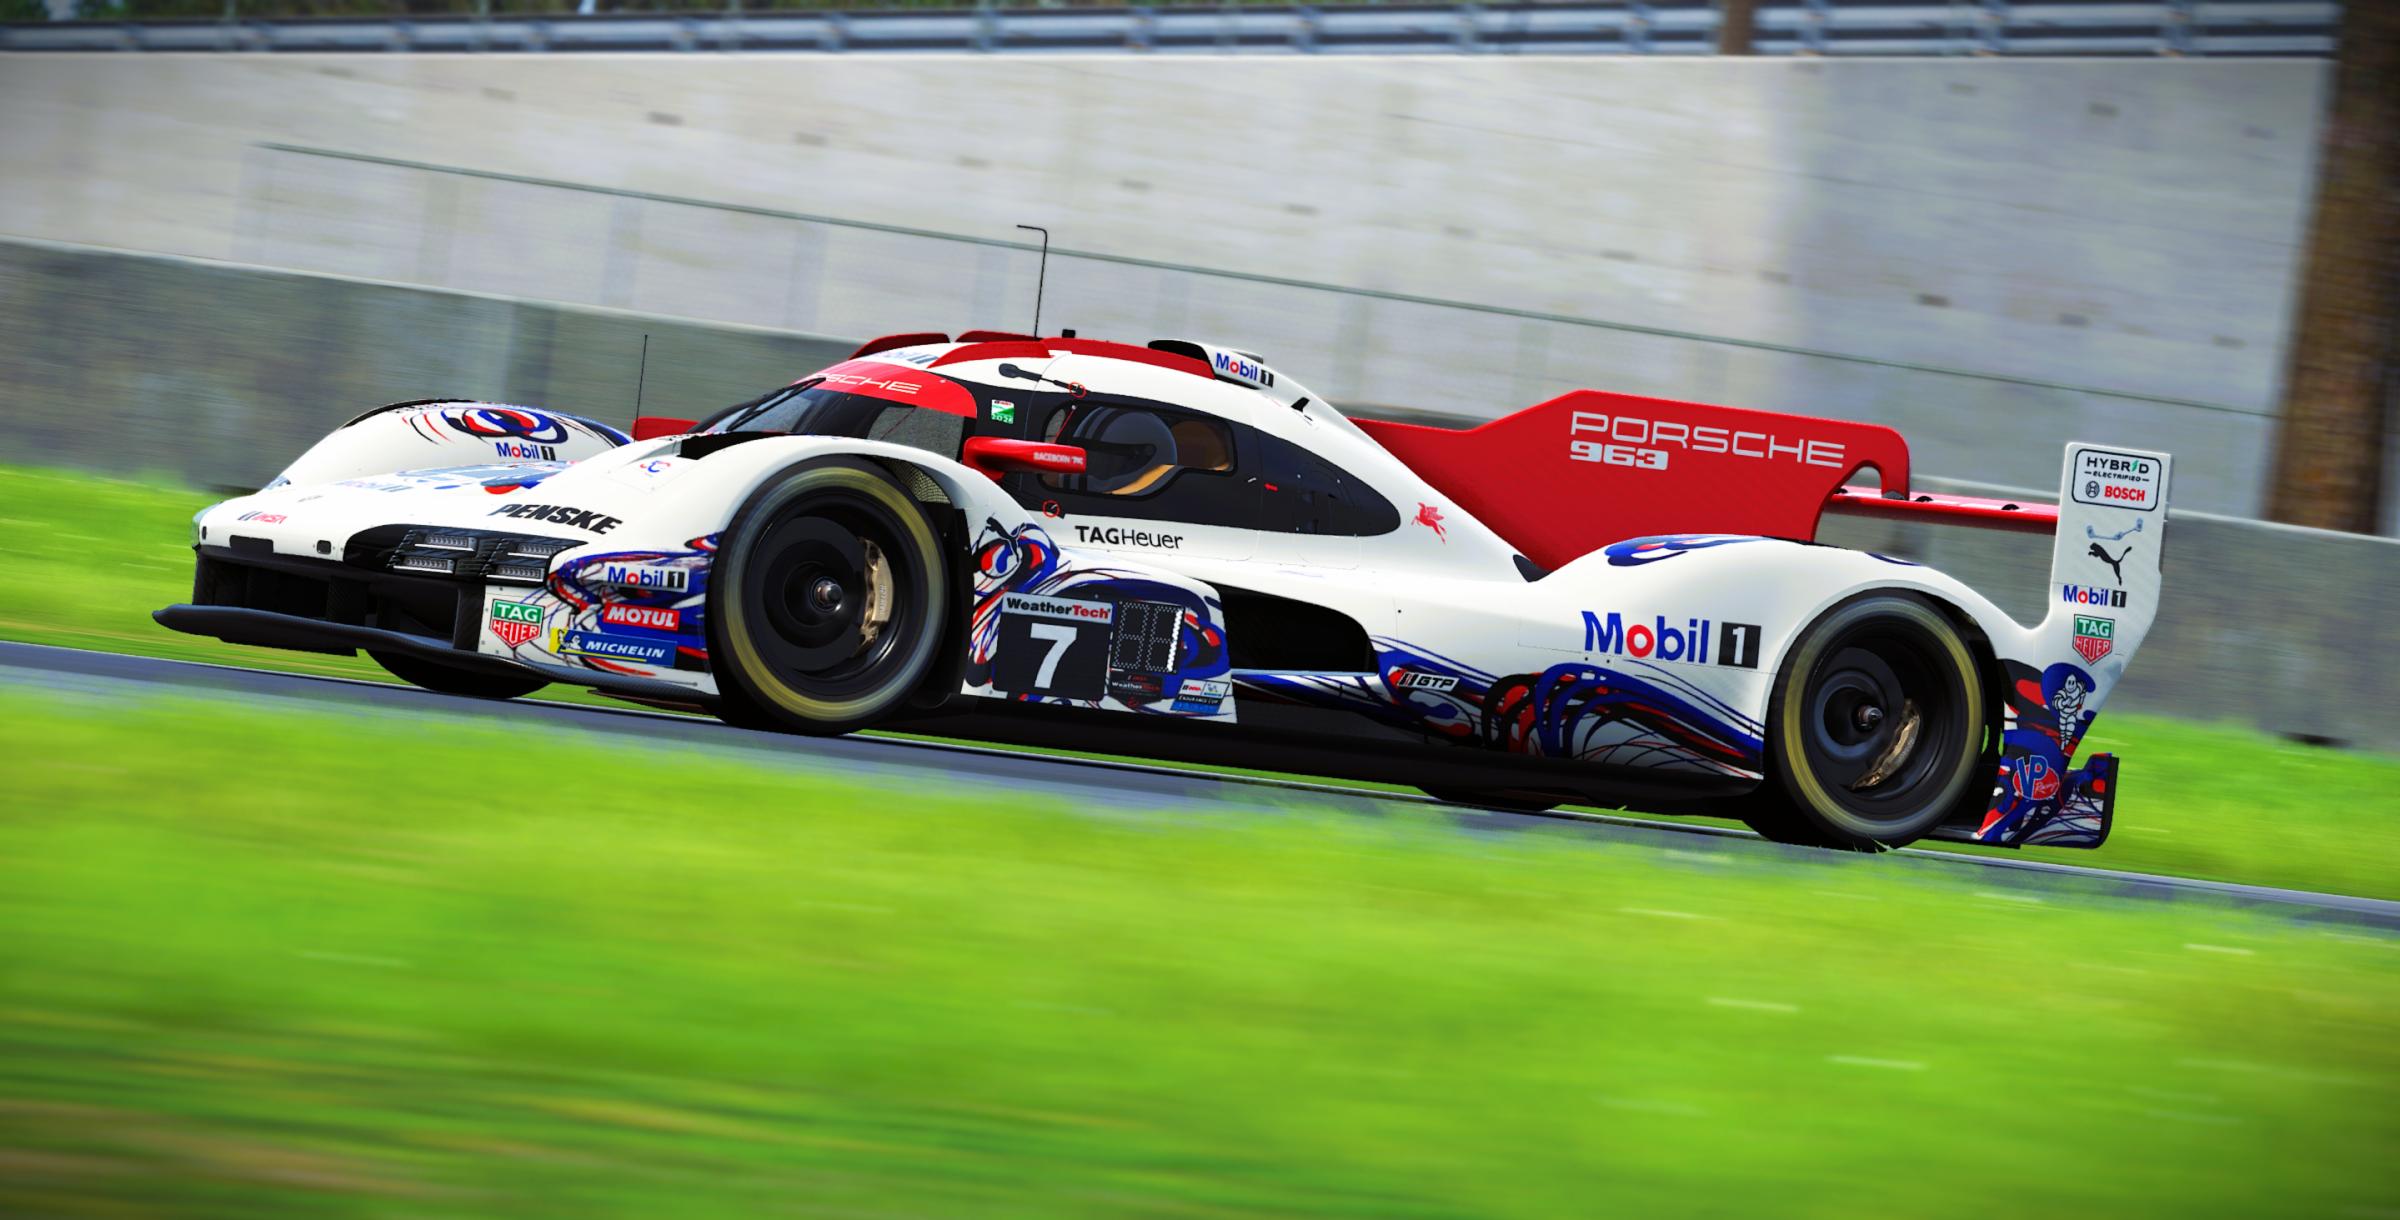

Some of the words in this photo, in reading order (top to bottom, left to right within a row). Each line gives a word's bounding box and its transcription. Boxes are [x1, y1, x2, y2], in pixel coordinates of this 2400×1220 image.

[1216, 352, 1257, 380] Mobil
[495, 441, 540, 460] Mobil
[1570, 411, 1846, 469] PORSCHE
[1569, 439, 1669, 471] 963
[2092, 471, 2141, 482] ELECTRIFIED
[2104, 485, 2145, 502] BOSCH
[486, 503, 623, 535] PENSKE
[607, 565, 664, 585] Mobil
[2063, 584, 2109, 606] Mobil
[497, 603, 538, 622] TAG
[606, 606, 675, 627] MOTUL
[1006, 597, 1111, 619] WeatherTech
[493, 619, 538, 644] HEUER
[1581, 610, 1710, 664] Mobil
[2078, 618, 2111, 637] TAG
[585, 640, 665, 658] MICHELIN
[1030, 622, 1078, 689] 7
[2075, 636, 2111, 660] HEUER
[1416, 675, 1455, 688] GTP
[2015, 754, 2049, 800] VP
